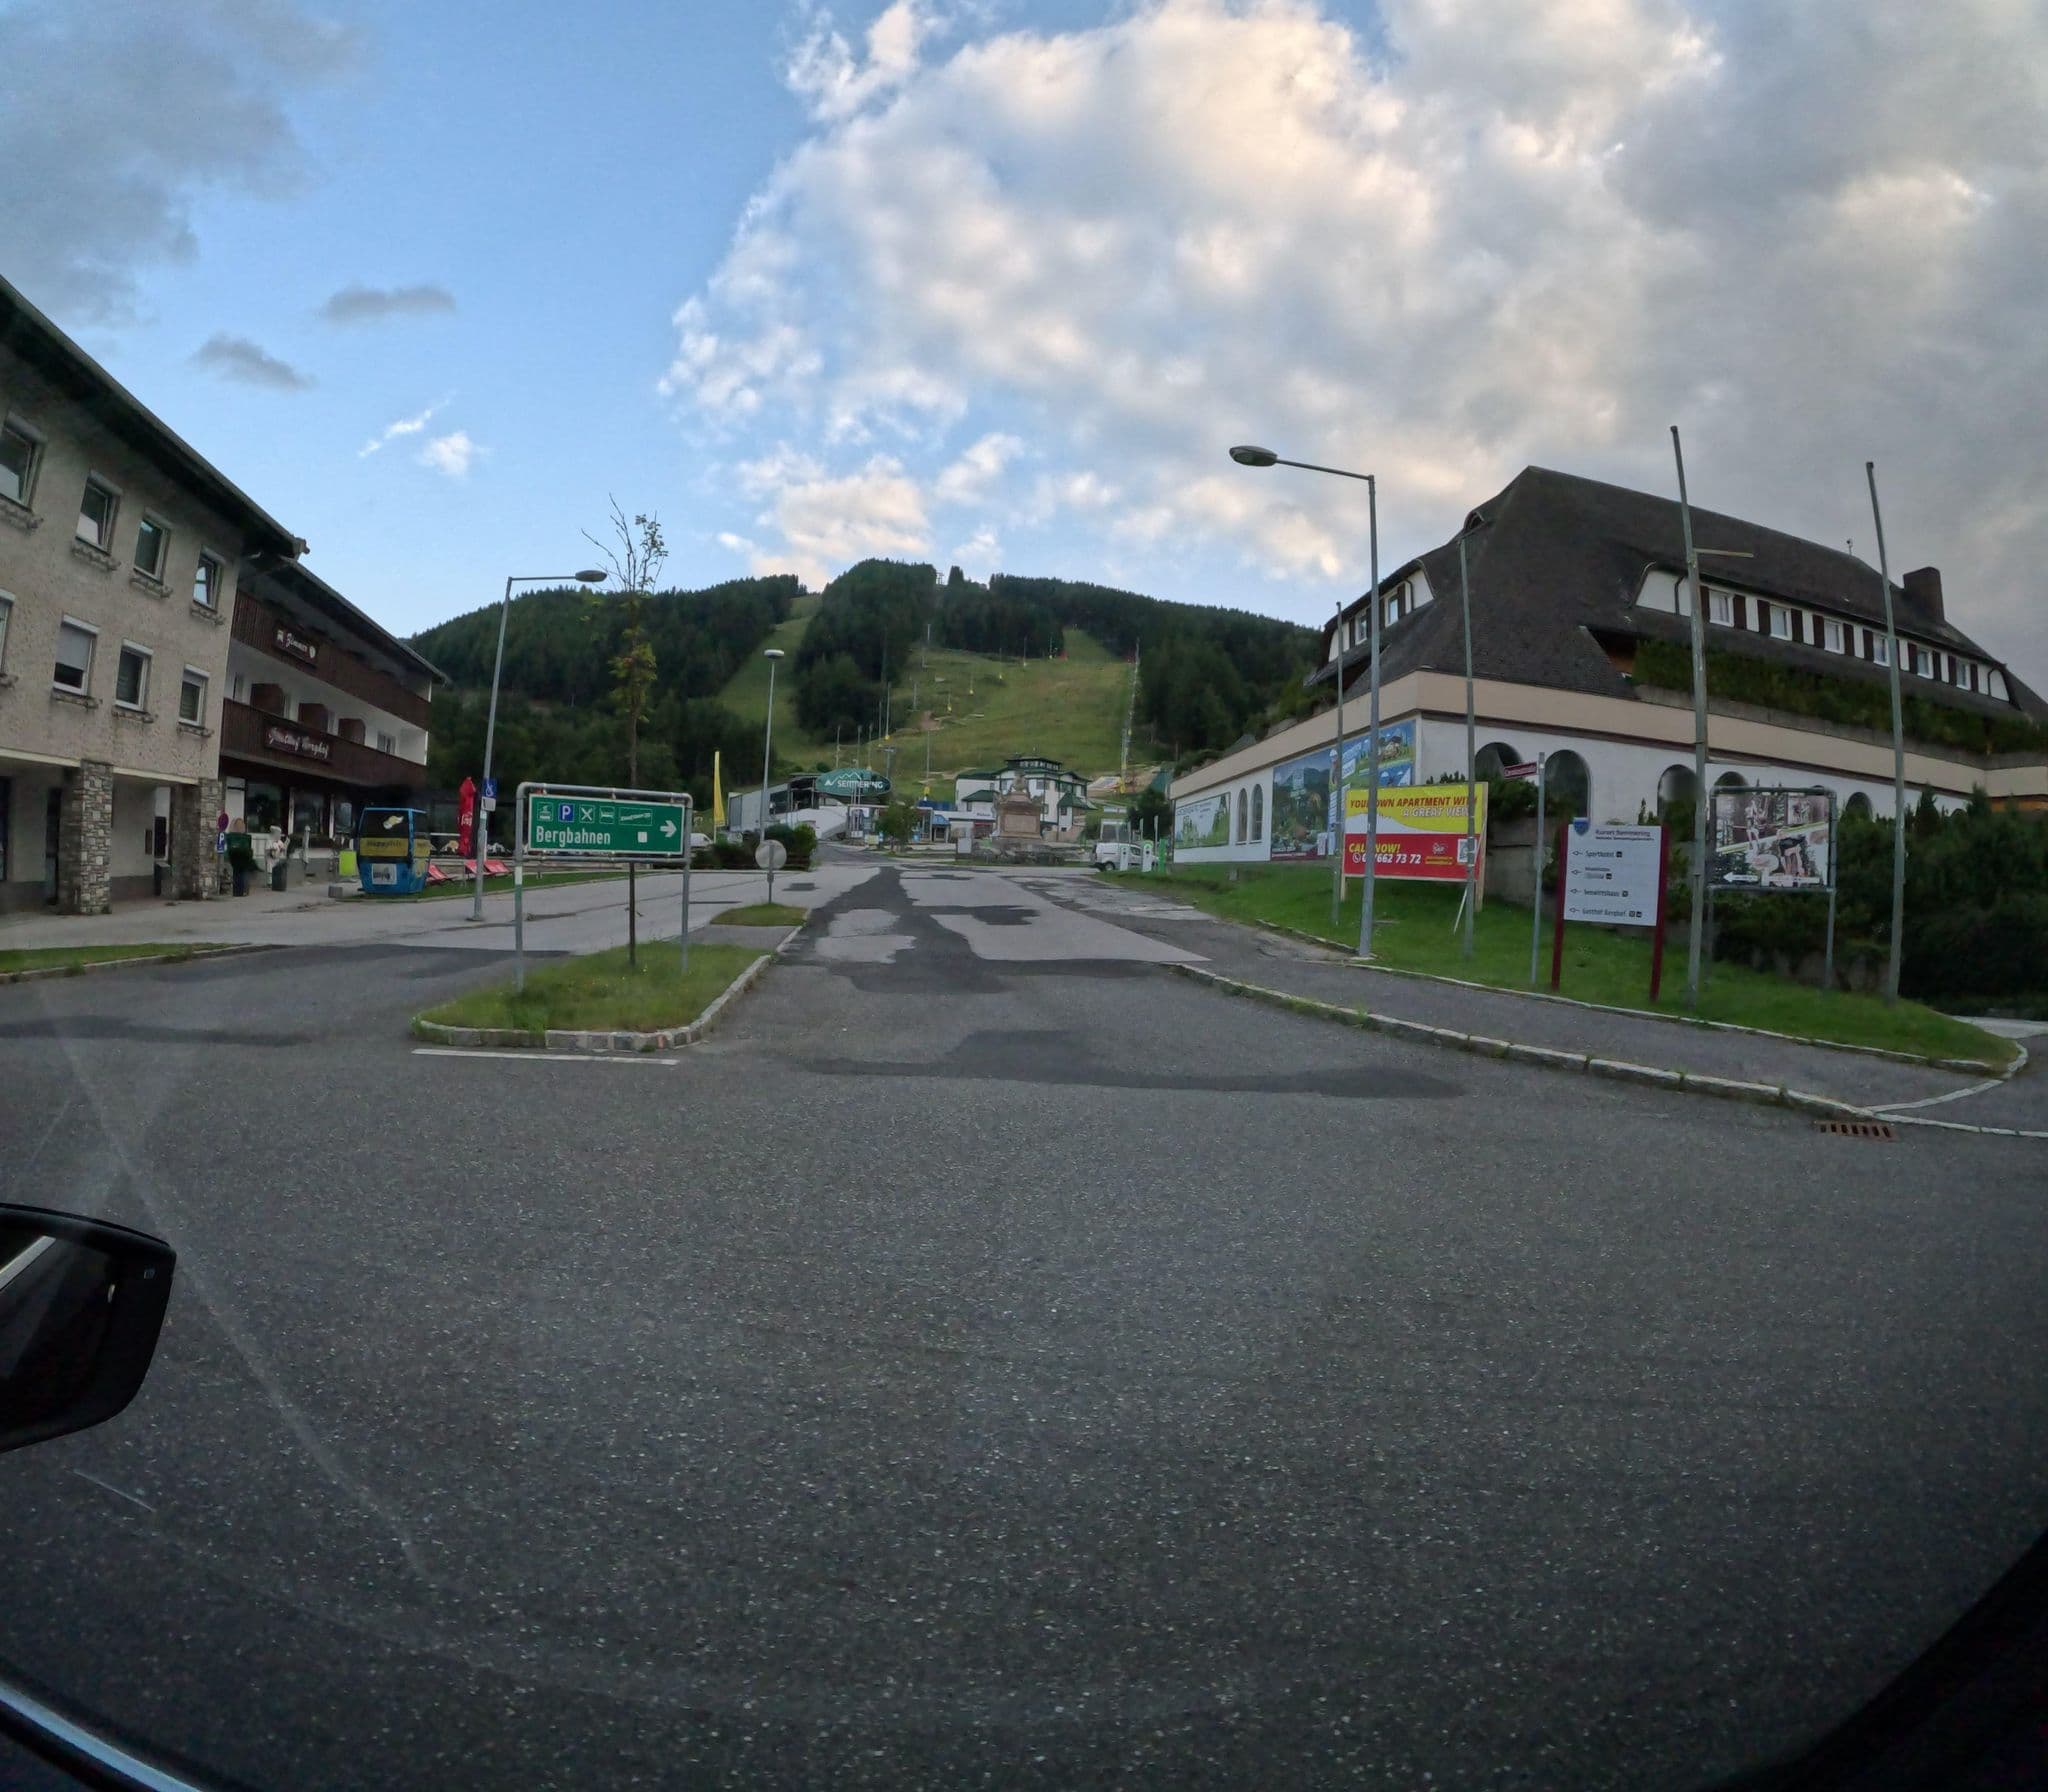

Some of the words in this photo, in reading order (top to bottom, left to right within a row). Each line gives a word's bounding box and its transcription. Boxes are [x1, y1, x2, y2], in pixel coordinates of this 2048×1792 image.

[1396, 797, 1450, 807] APARTMENT
[562, 805, 571, 819] P
[1412, 807, 1442, 816] GREAT
[536, 826, 610, 847] Bergbahnen
[1395, 854, 1407, 864] 73
[1409, 854, 1421, 864] 72
